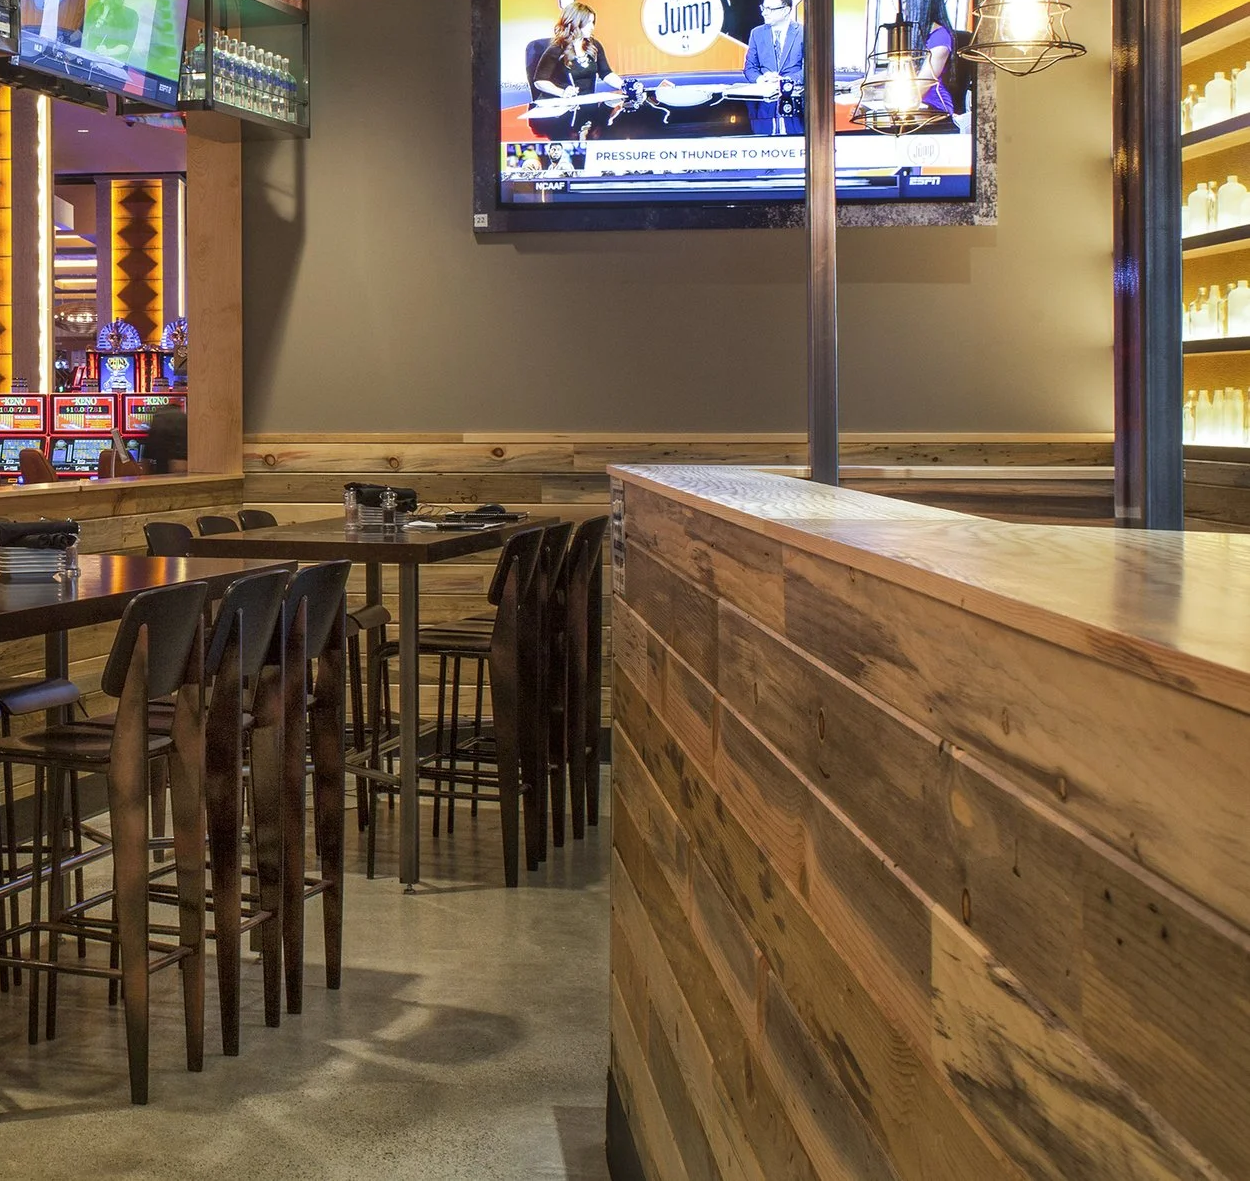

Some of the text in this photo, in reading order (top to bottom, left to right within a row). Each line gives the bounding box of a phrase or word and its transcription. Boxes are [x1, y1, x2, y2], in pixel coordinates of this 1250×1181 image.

[658, 1, 711, 36] Jump
[596, 151, 656, 161] PRESSURE
[659, 151, 677, 160] ON
[682, 149, 738, 160] THUNDER
[742, 149, 758, 158] TO
[761, 149, 796, 158] MOVE
[909, 177, 941, 185] ESPN
[535, 182, 565, 190] NCAAF
[3, 397, 27, 406] KENO
[73, 397, 98, 406] KENO
[146, 397, 169, 405] KENO
